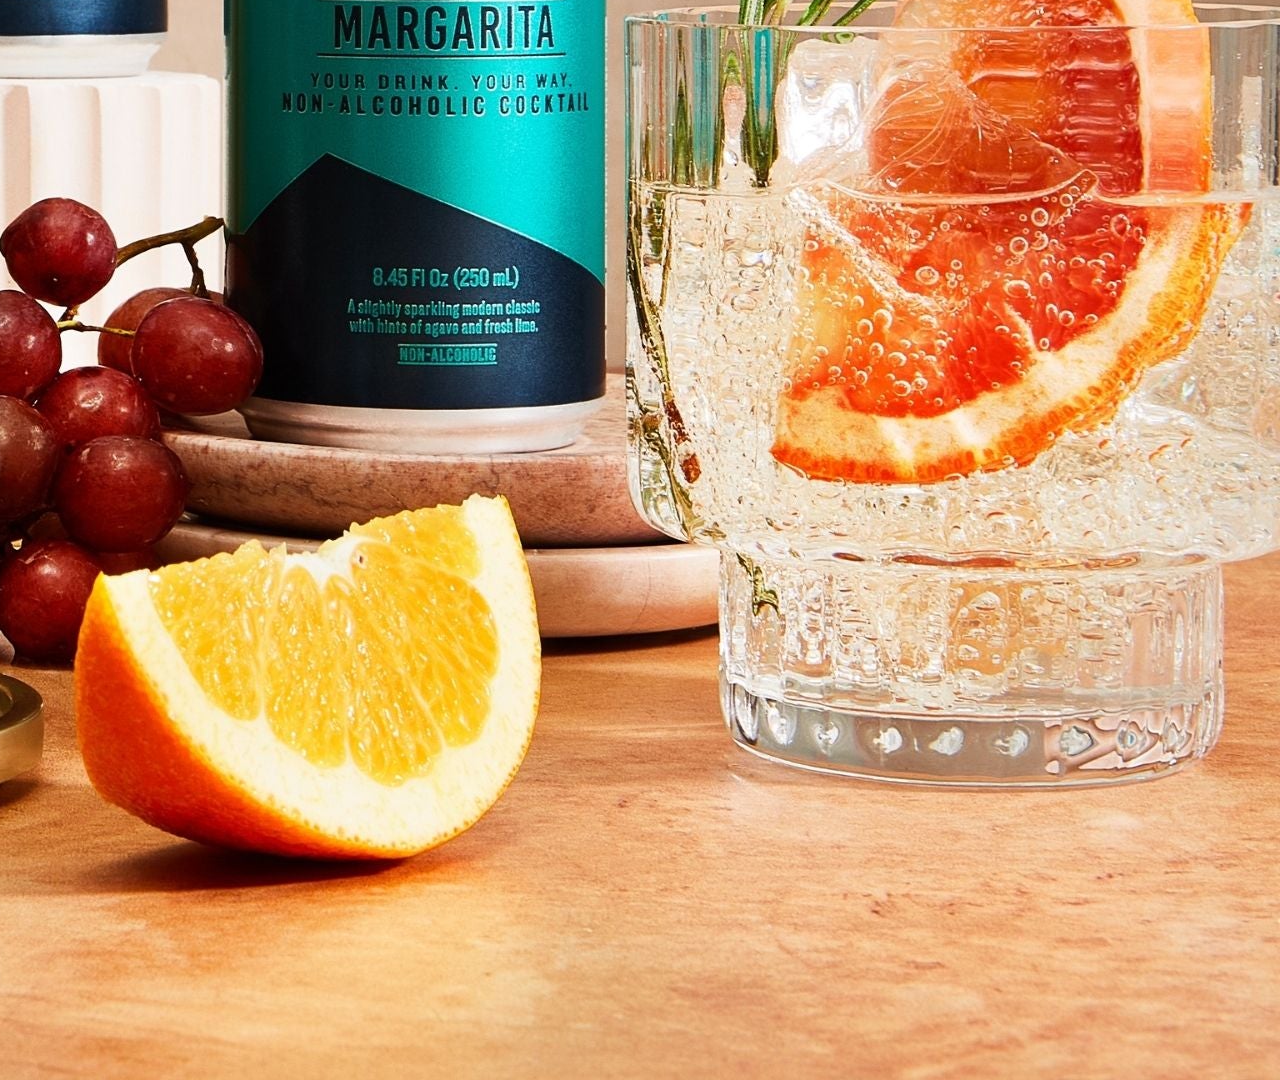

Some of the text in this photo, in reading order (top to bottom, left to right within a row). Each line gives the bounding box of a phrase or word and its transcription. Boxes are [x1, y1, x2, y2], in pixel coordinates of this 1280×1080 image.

[334, 4, 555, 49] MARGARITA
[311, 73, 572, 90] YOUR DRINK. YOUR WAY.
[282, 92, 590, 116] NON-ALCOHOLIC COCKTAIL
[373, 267, 408, 288] 8.45
[429, 268, 449, 287] Oz
[453, 266, 488, 290] (250
[493, 265, 519, 289] mL)
[347, 298, 541, 319] A slightly sparkling modern classic
[350, 317, 538, 338] with hints of agave and fresh lime.
[398, 346, 497, 362] NON-ALCOHOLIC
